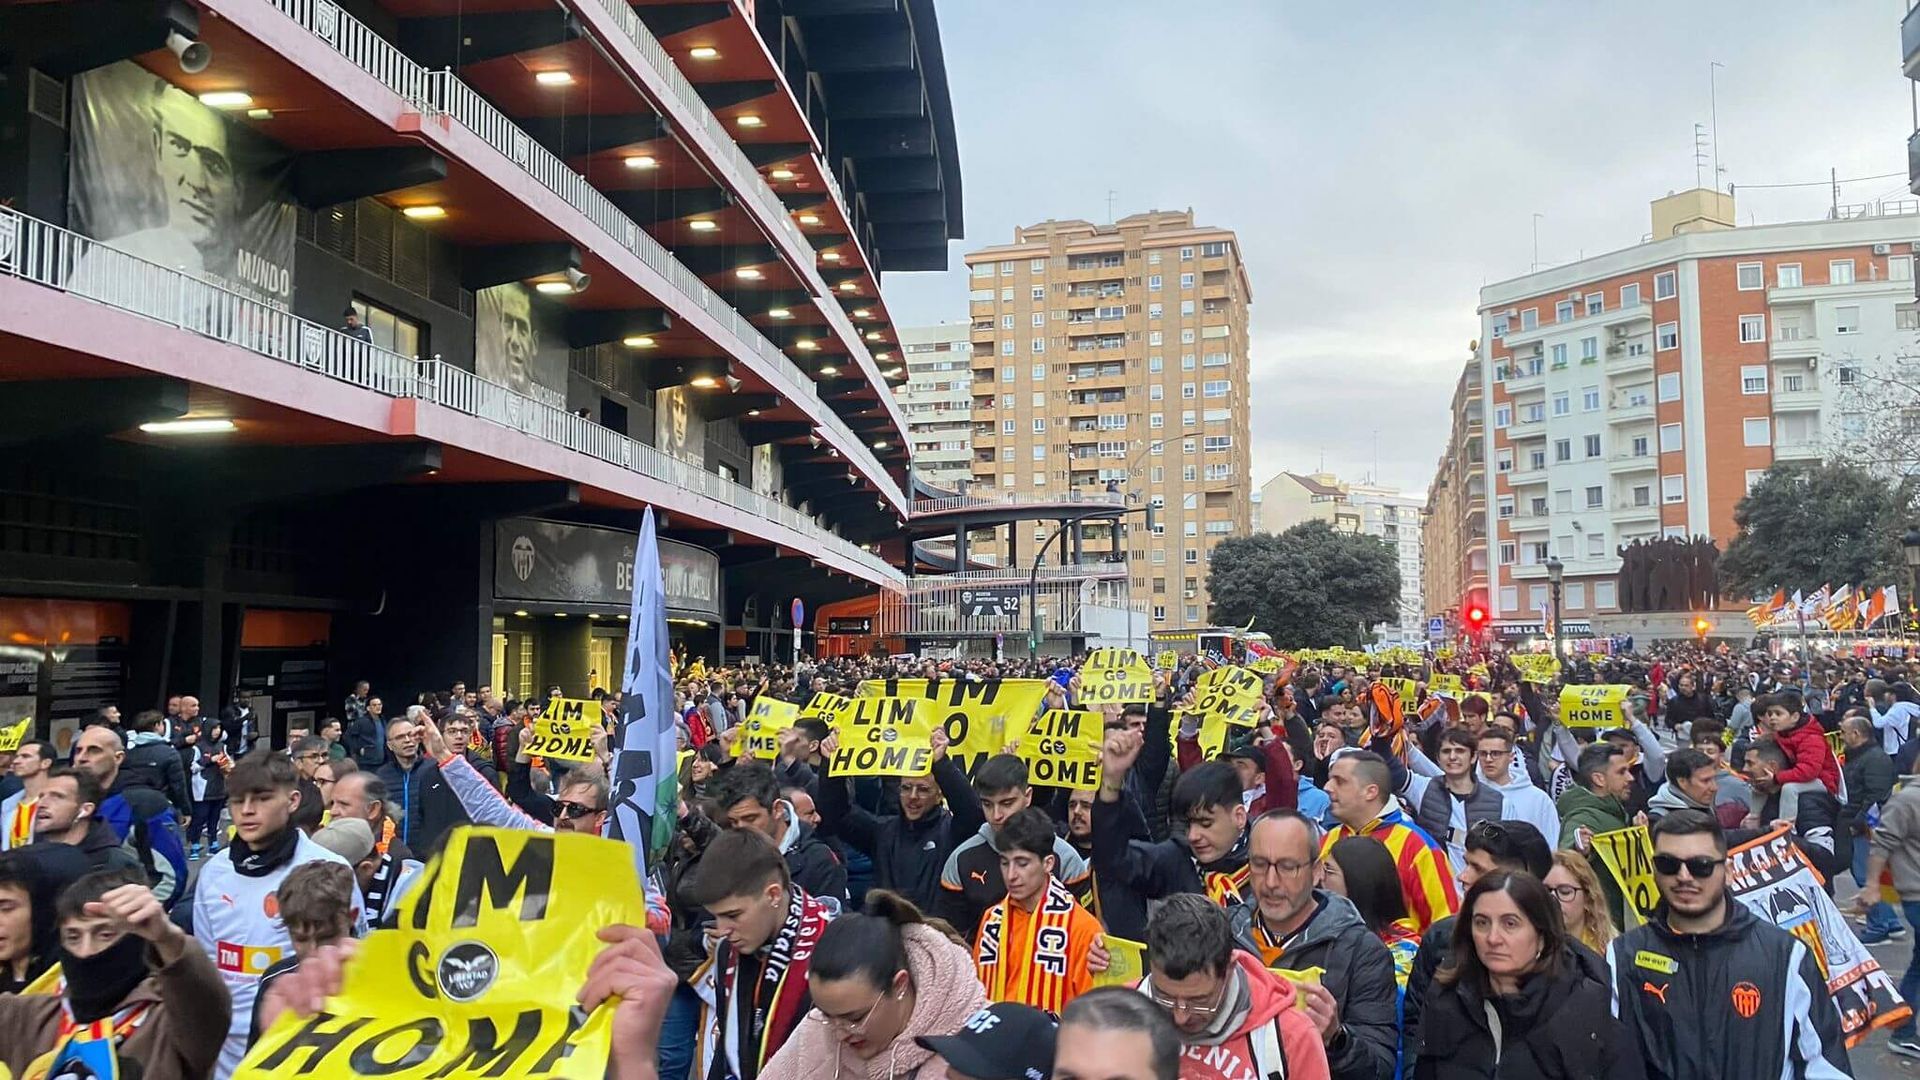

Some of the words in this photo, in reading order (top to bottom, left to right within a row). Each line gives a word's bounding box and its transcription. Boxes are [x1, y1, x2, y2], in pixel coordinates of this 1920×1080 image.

[237, 248, 290, 297] MUNDO
[1003, 596, 1019, 610] 52
[1503, 625, 1522, 634] BAR
[1523, 625, 1537, 634] LA
[1092, 650, 1138, 669] LIM
[811, 689, 850, 712] LIM
[1080, 683, 1151, 701] HOME
[854, 699, 917, 725] LIM
[1200, 695, 1257, 721] OME
[1569, 710, 1613, 721] HOME
[1028, 712, 1082, 738] LIM
[526, 735, 595, 758] HOME
[832, 746, 932, 772] HOME
[220, 949, 239, 967] TM
[1034, 926, 1068, 976] CF
[448, 969, 489, 984] LIBERTAD
